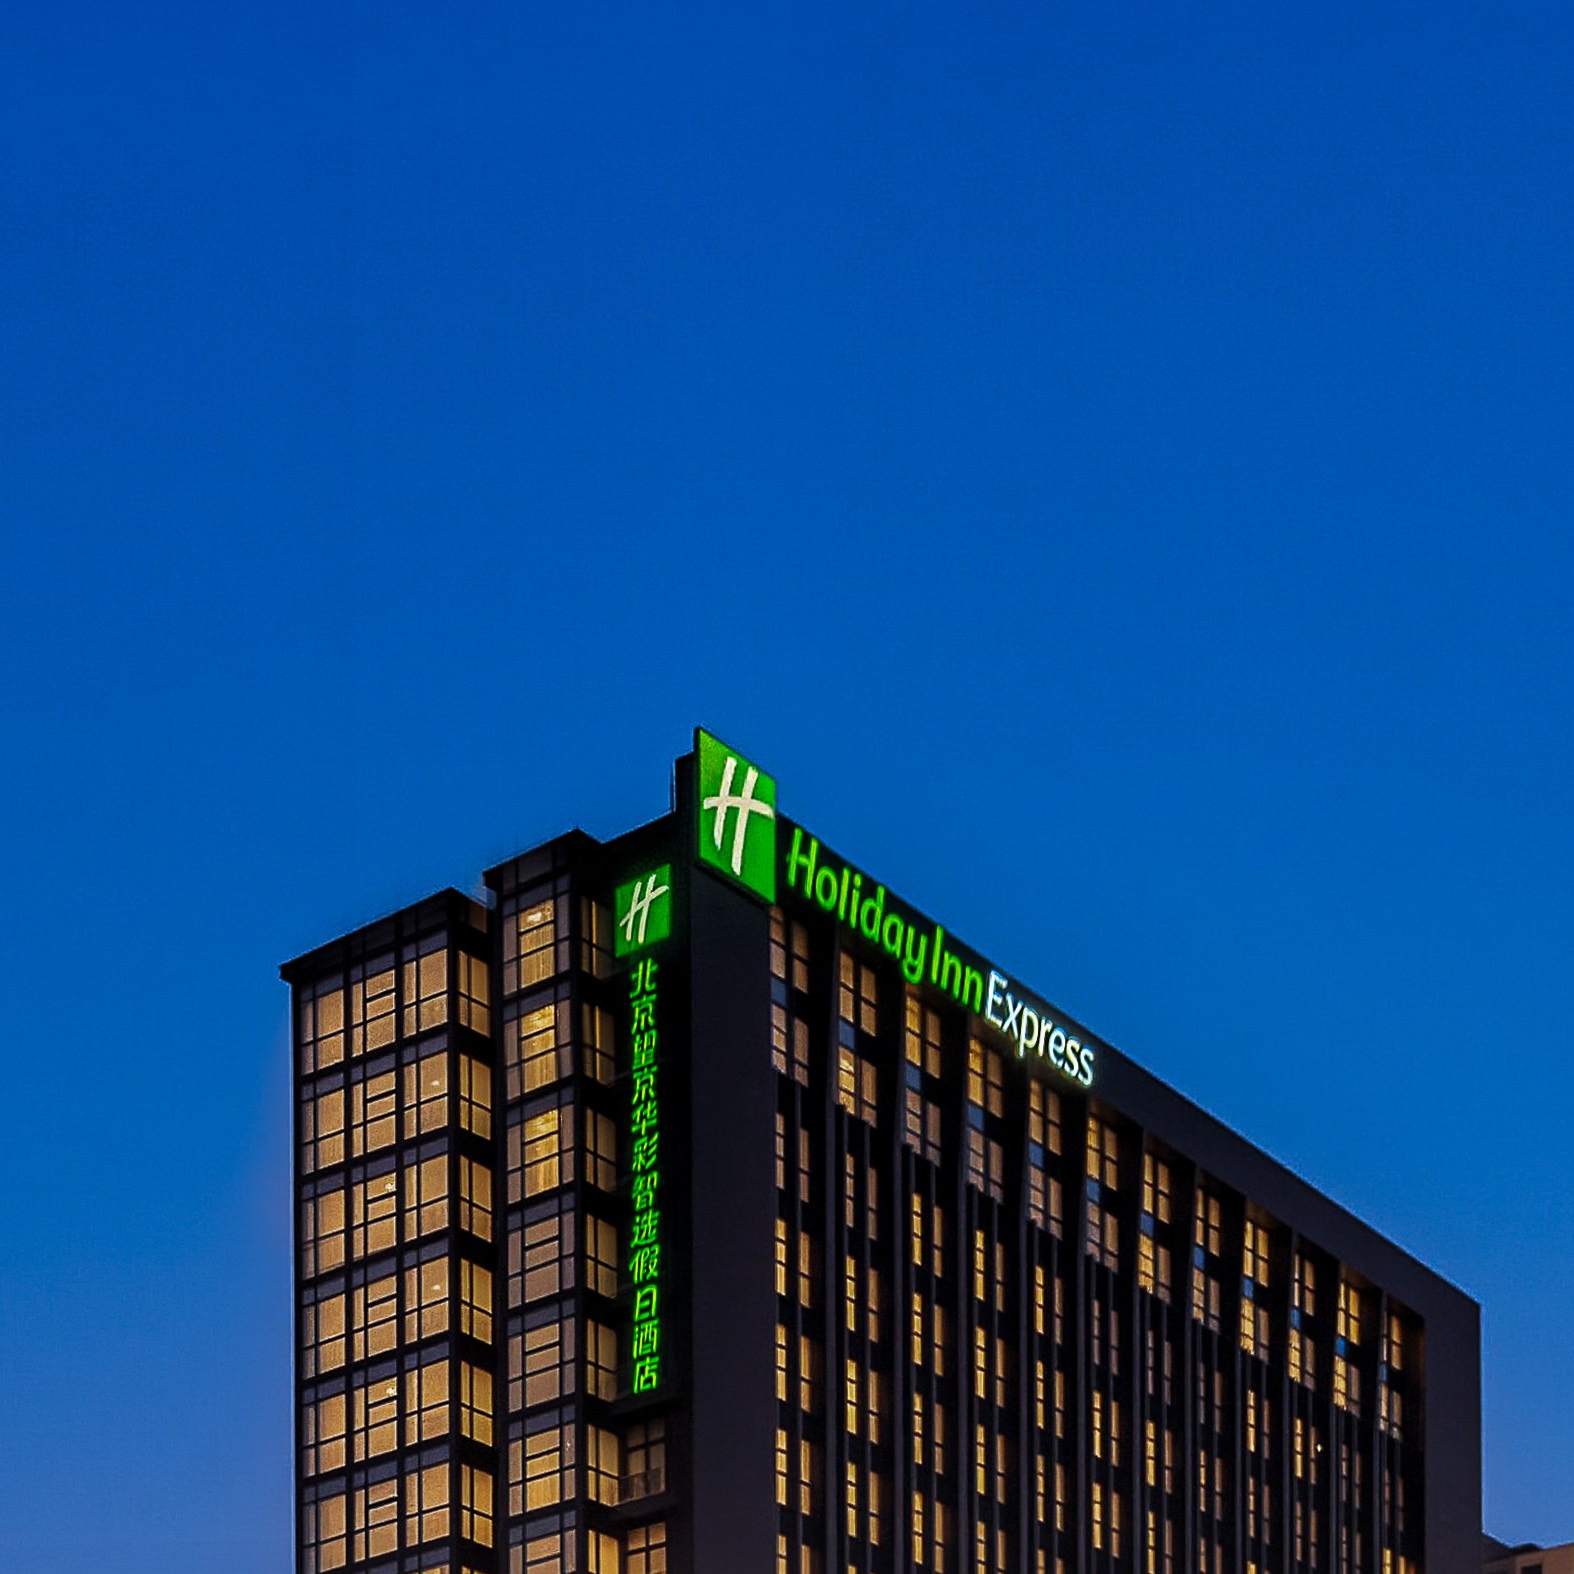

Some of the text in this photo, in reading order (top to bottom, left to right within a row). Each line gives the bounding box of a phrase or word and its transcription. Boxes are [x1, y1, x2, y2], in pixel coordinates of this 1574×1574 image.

[786, 828, 1095, 1088] Holiday Inn Express
[629, 957, 659, 1395] 北京望京华彩智选假日酒店
